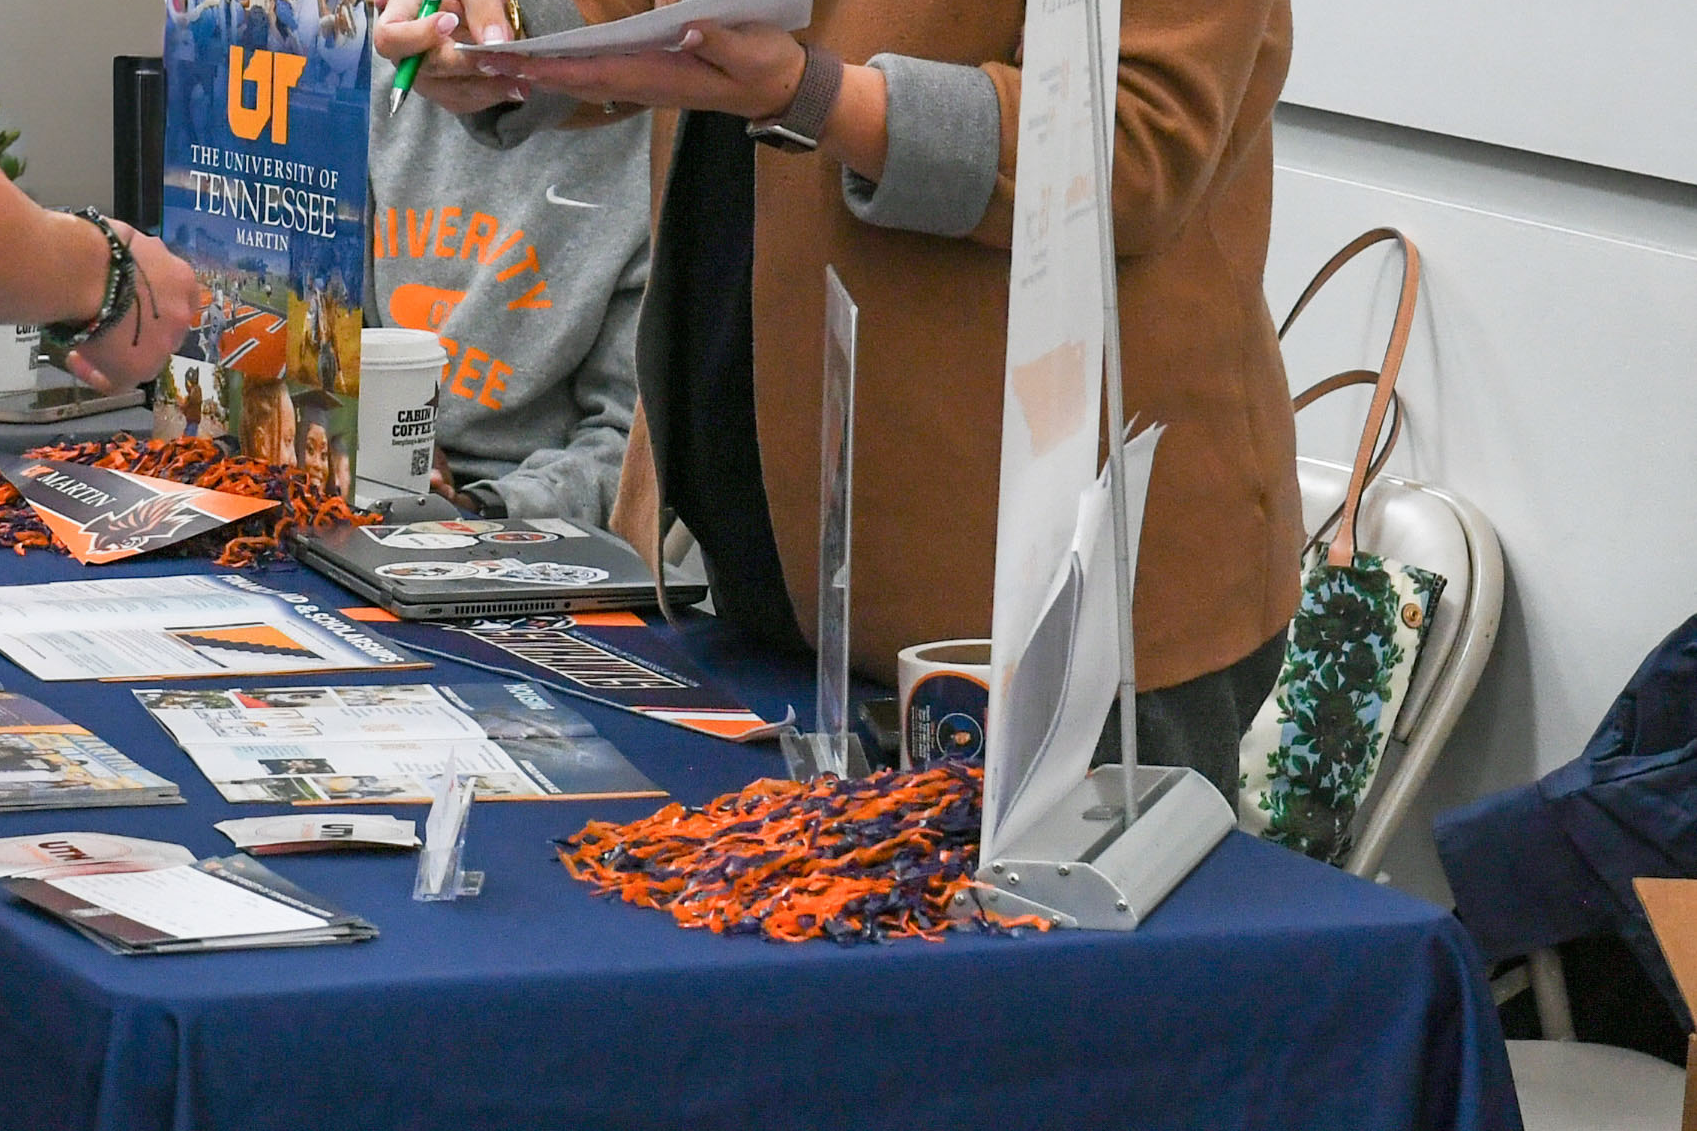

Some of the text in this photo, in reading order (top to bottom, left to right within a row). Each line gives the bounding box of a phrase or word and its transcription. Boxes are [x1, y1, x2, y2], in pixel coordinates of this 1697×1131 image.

[227, 45, 307, 145] UT
[190, 144, 339, 190] THE UNIVERSITY OF
[190, 170, 337, 239] TENNESSEE
[235, 227, 289, 252] MARTIN
[392, 421, 432, 437] COFFEE
[397, 408, 432, 423] CABIN
[36, 471, 118, 508] MARTIN
[305, 612, 405, 663] SCHOLARSHIPS
